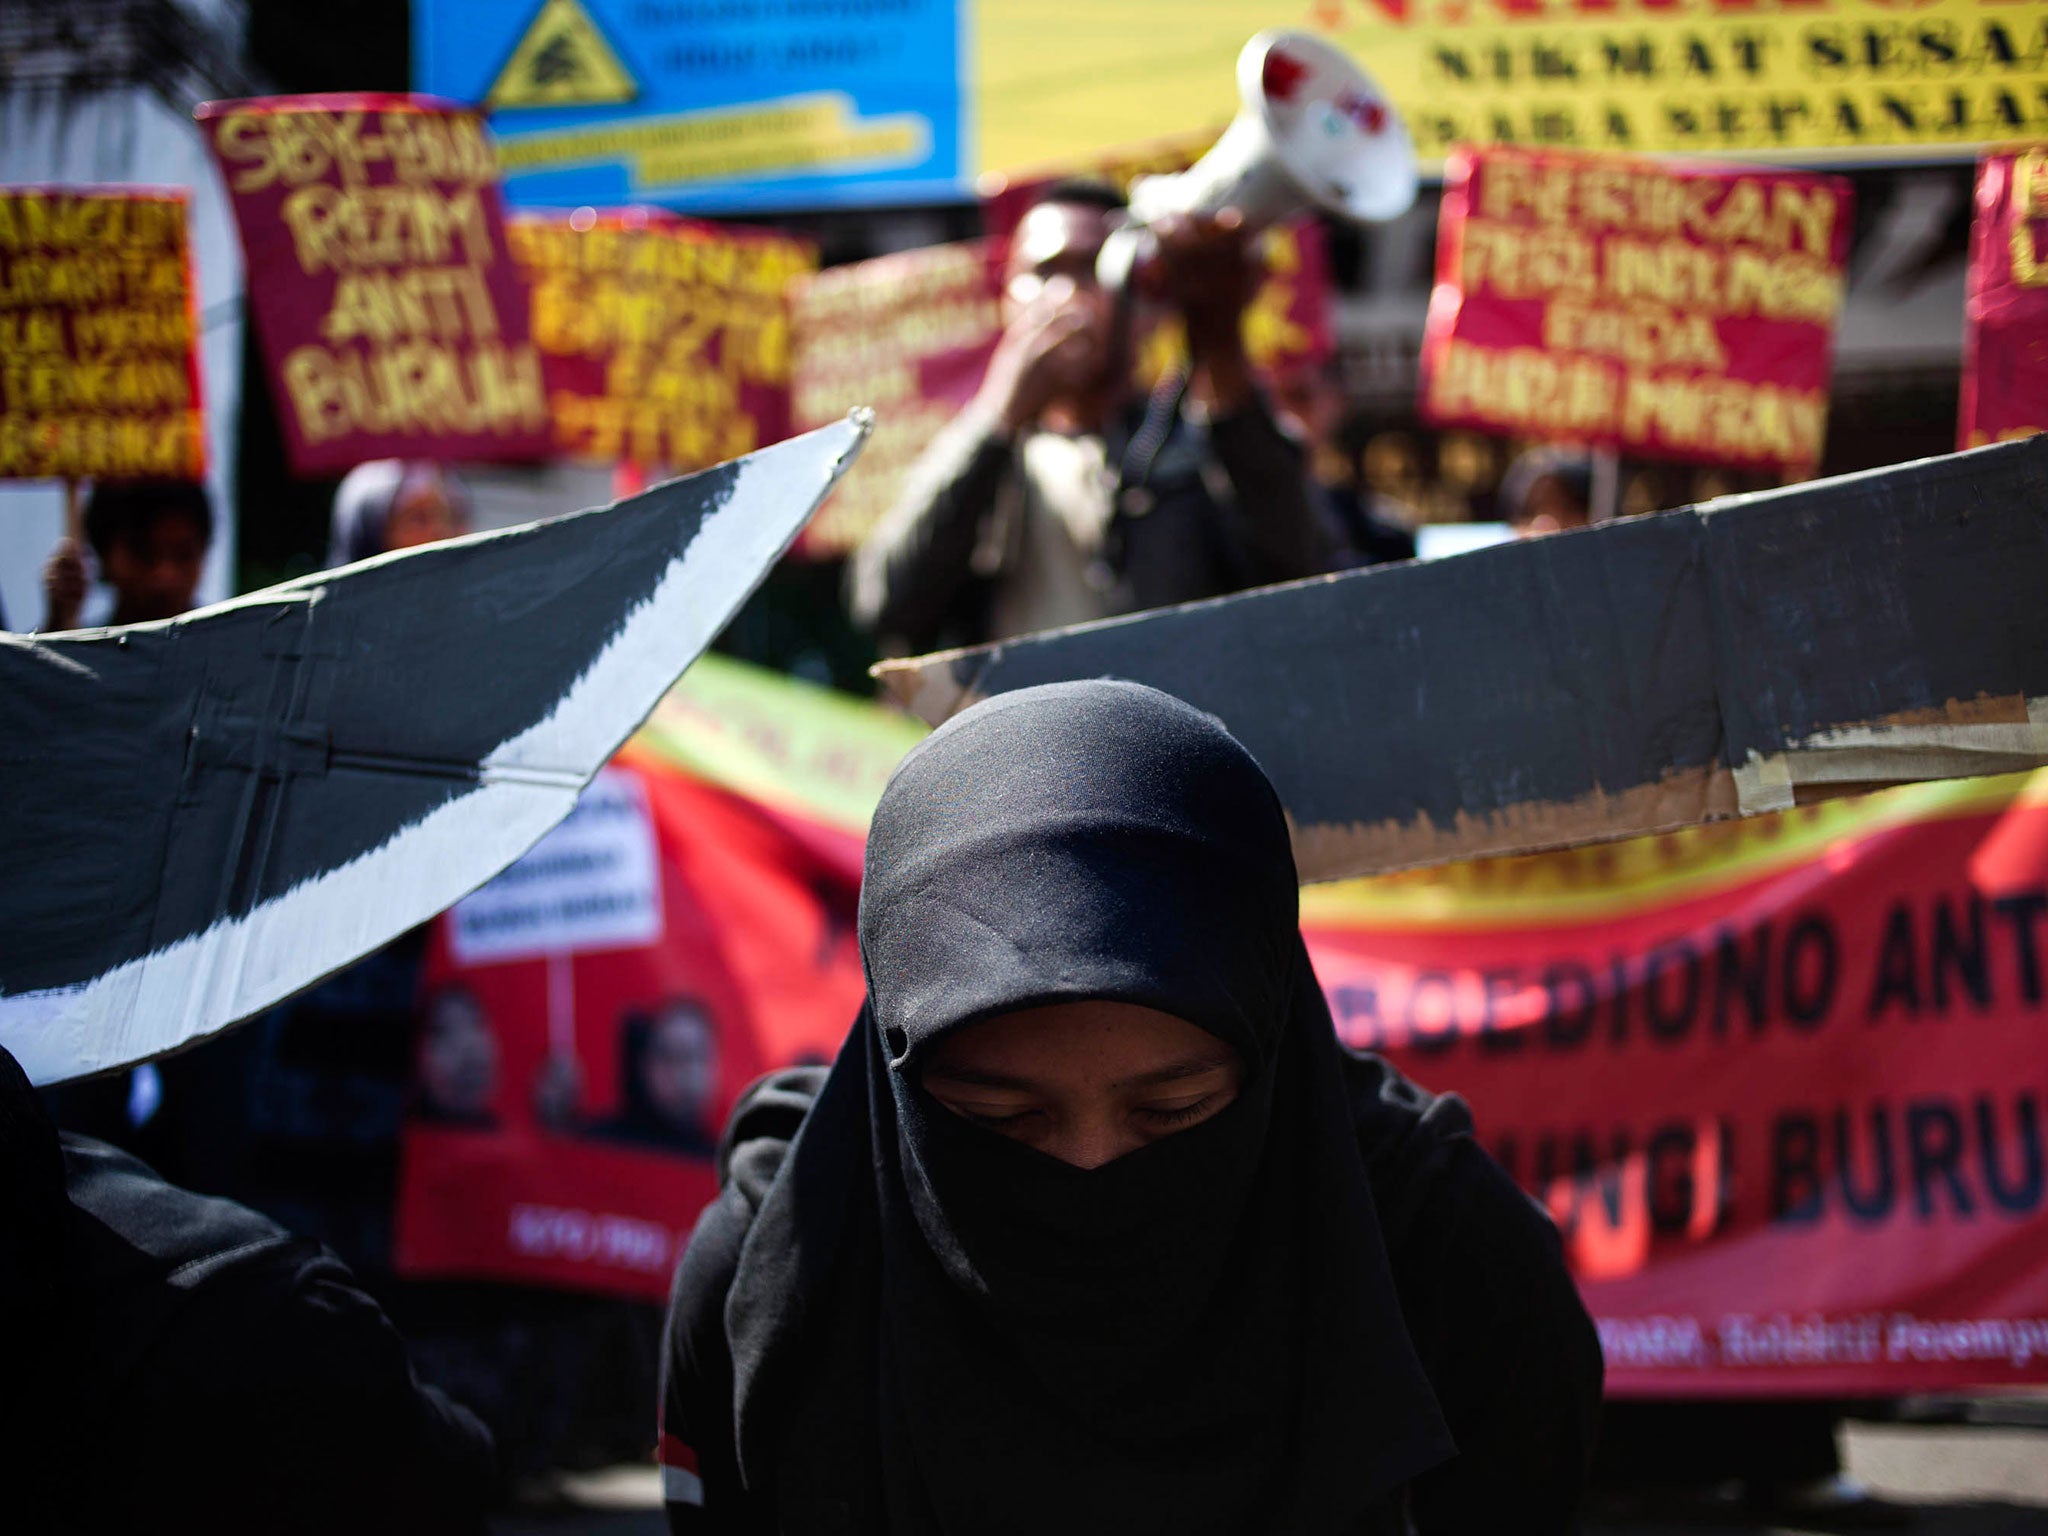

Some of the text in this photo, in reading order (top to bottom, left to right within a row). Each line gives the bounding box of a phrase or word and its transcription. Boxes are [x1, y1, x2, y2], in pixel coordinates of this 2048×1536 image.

[1425, 28, 1768, 86] NIKMAT
[1660, 84, 2048, 147] SEPANJA
[281, 183, 495, 277] REZIM
[320, 264, 498, 345] ANTI
[281, 341, 547, 447] BURUH
